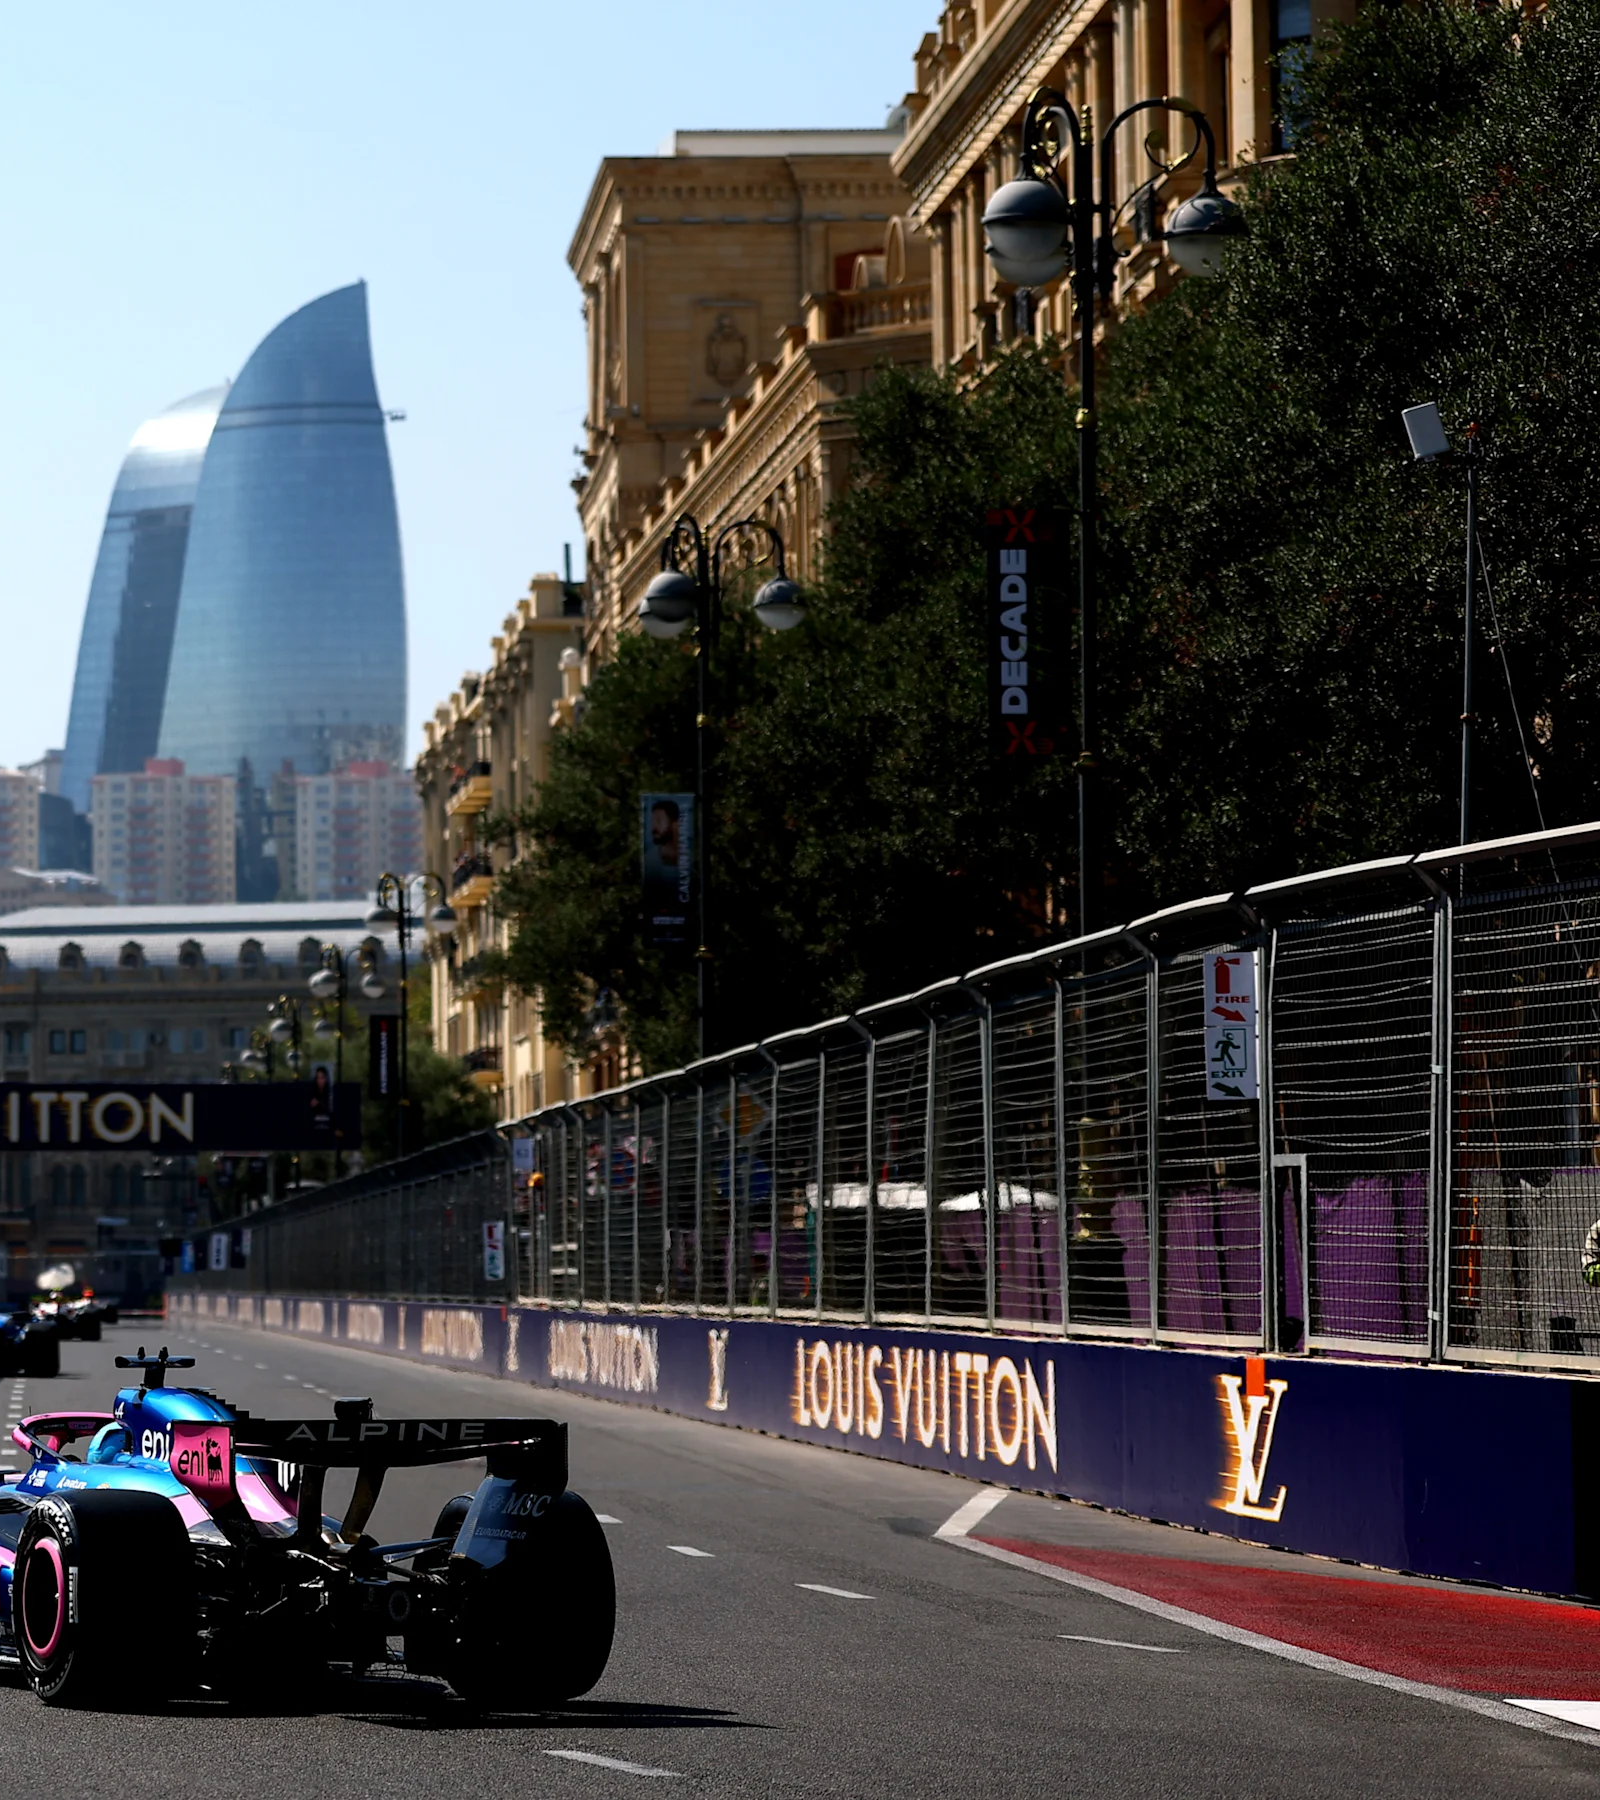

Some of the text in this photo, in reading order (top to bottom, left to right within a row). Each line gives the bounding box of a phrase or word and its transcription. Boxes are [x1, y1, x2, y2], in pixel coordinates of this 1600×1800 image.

[1000, 548, 1029, 715] DECADE
[1215, 995, 1251, 1004] FIRE
[1211, 1070, 1247, 1079] EXIT
[795, 1337, 1059, 1474] LOUIS VUITTON
[141, 1422, 171, 1463] eni
[285, 1423, 486, 1442] ALPINE
[178, 1440, 205, 1476] eni
[501, 1491, 553, 1518] MSC
[474, 1526, 528, 1541] EURODATACAR
